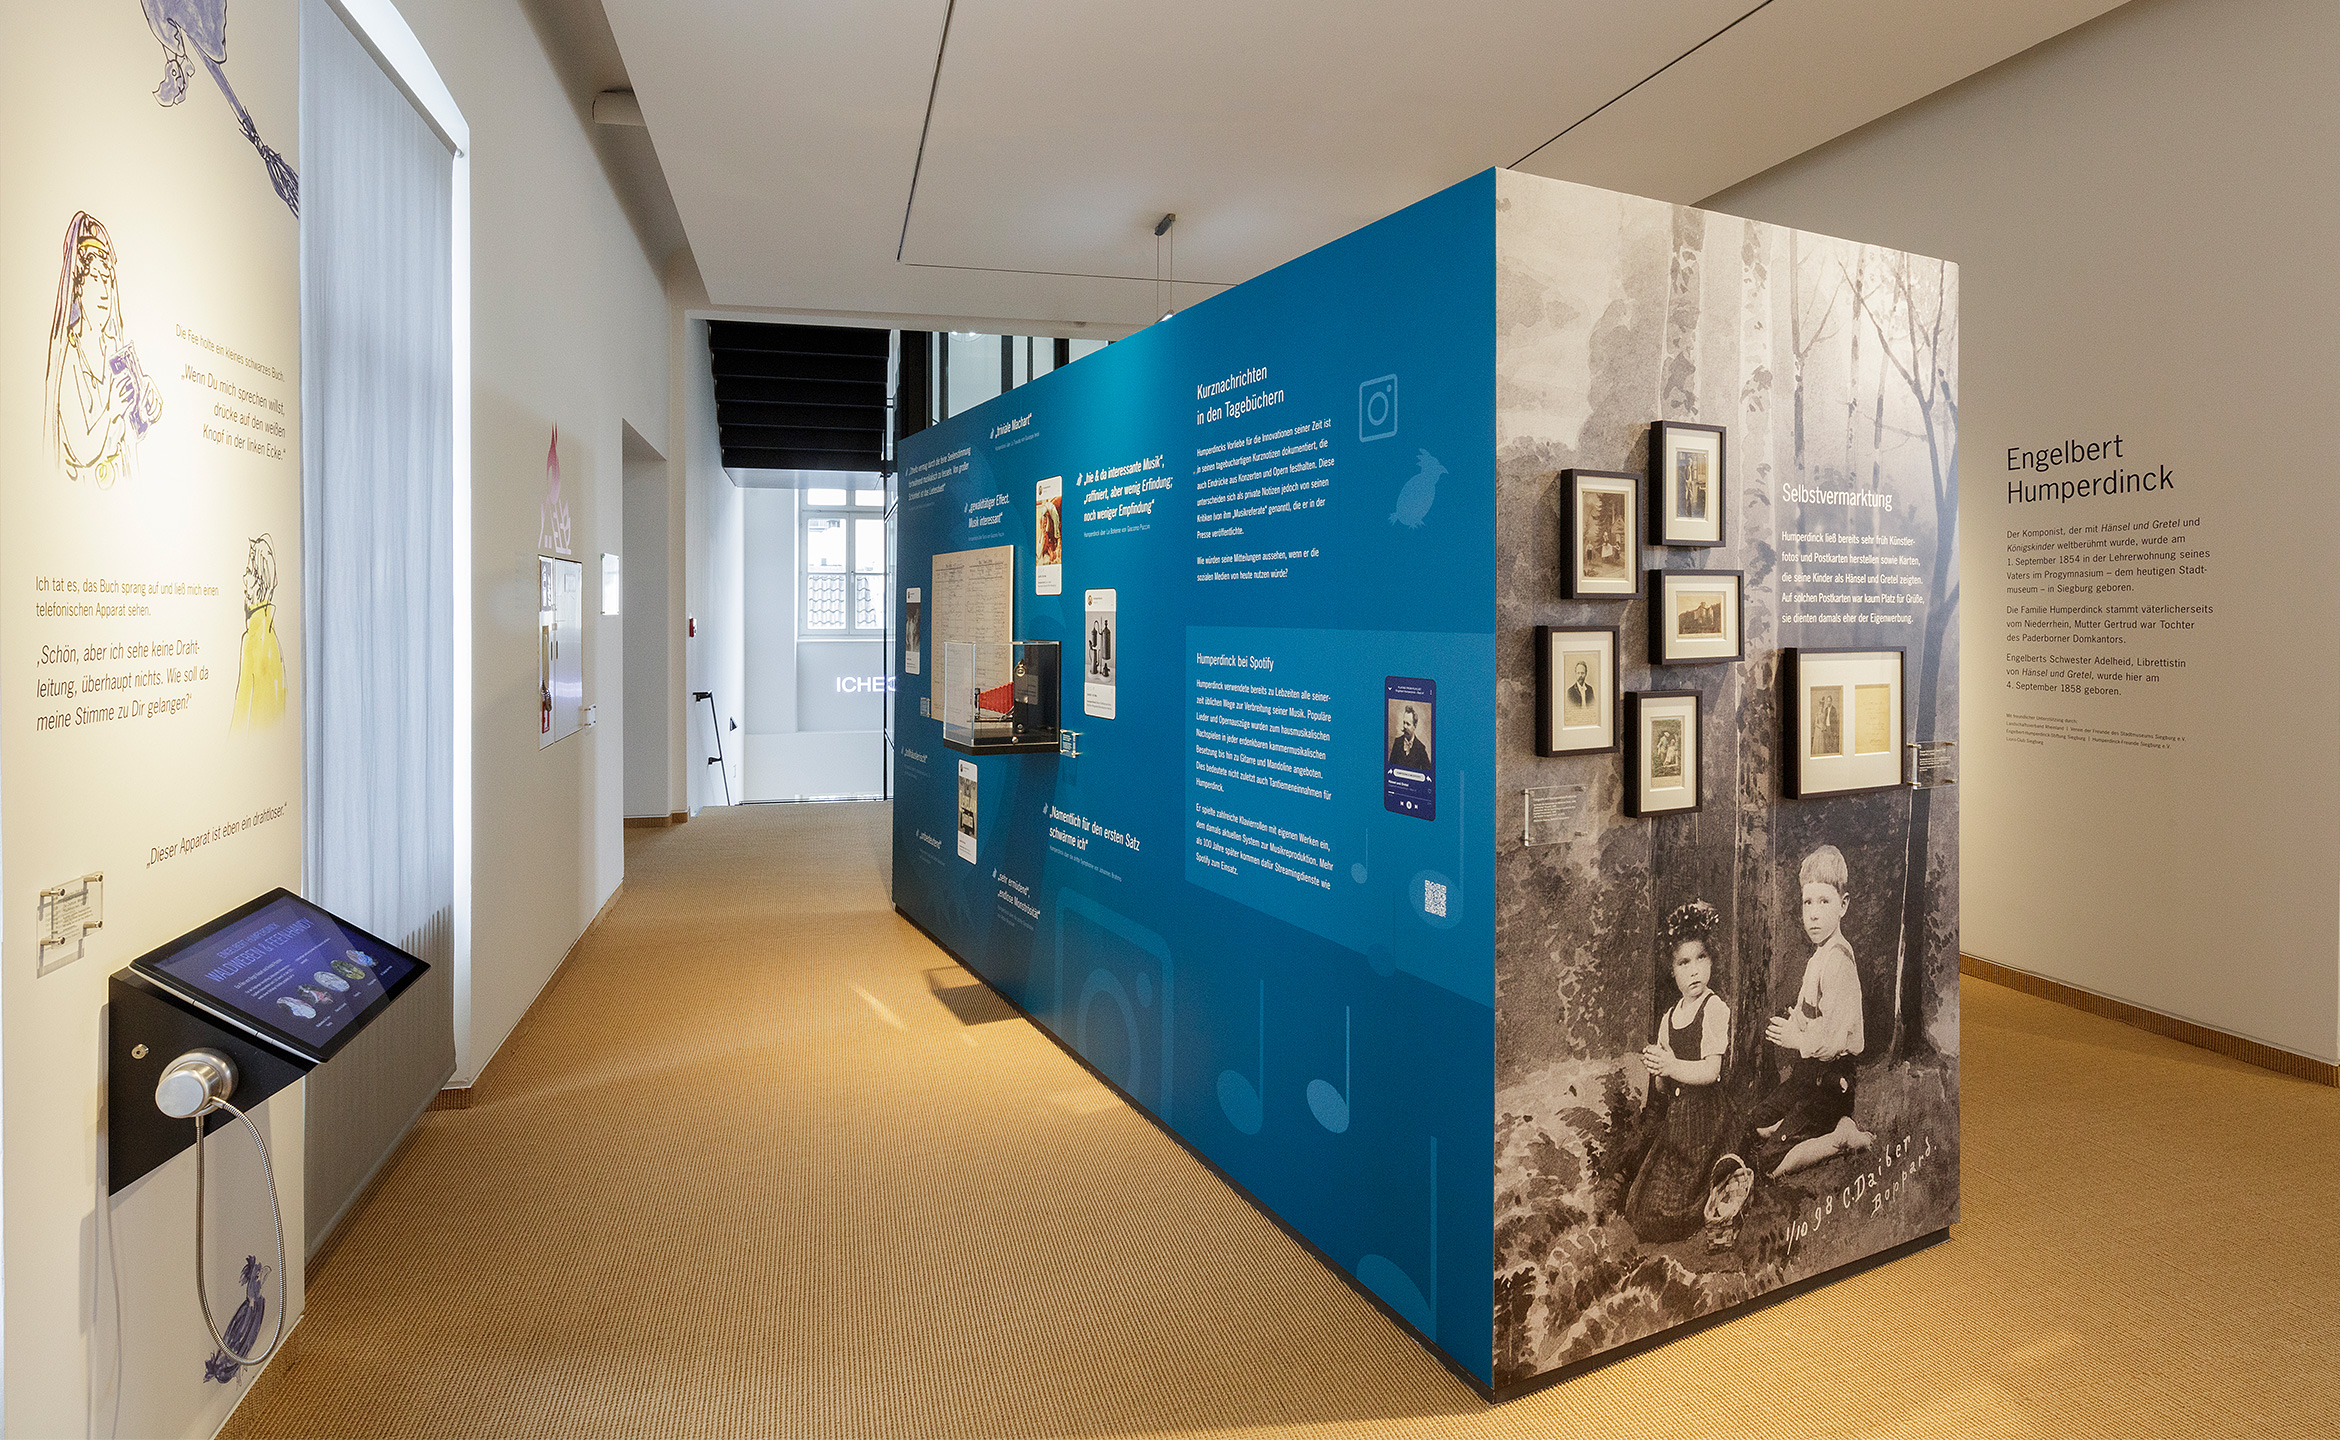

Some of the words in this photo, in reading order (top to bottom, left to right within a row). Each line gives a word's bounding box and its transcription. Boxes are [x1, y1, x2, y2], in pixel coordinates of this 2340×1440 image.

[176, 325, 186, 341] Die
[188, 330, 199, 346] Fee
[200, 335, 214, 353] holte
[216, 343, 224, 357] ein
[225, 346, 244, 365] kleines
[245, 356, 271, 376] schwarzes
[271, 365, 285, 382] Buch.
[207, 373, 218, 391] Du
[219, 380, 236, 397] mich
[237, 387, 267, 408] sprechen
[268, 397, 285, 416] willst,
[1197, 367, 1267, 400] Kurznachrichten
[214, 404, 238, 424] drücke
[239, 414, 250, 427] auf
[251, 415, 263, 431] den
[265, 422, 286, 438] weißen
[1197, 409, 1204, 426] in
[1206, 406, 1222, 423] den
[1224, 390, 1284, 419] Tagebüchern
[203, 424, 225, 447] Knopf
[226, 431, 232, 447] in
[234, 434, 246, 450] der
[247, 437, 265, 456] linken
[2007, 436, 2123, 473] Engelbert
[1094, 469, 1099, 483] &
[1100, 468, 1107, 482] da
[1108, 462, 1142, 480] interessante
[1142, 455, 1164, 473] Musik“,
[1110, 486, 1123, 499] aber
[1124, 482, 1141, 497] wenig
[1141, 478, 1173, 494] Erfindung;
[1782, 483, 1892, 513] Selbstvermarktung
[2008, 466, 2174, 505] Humperdinck
[1083, 508, 1096, 522] noch
[1097, 507, 1118, 521] weniger
[2007, 530, 2020, 539] Der
[2022, 527, 2066, 539] Komponist,
[2068, 525, 2082, 535] der
[2085, 524, 2098, 534] mit
[2101, 522, 2130, 533] Hänsel
[2133, 520, 2150, 531] und
[2152, 518, 2180, 530] Gretel
[2183, 517, 2200, 528] und
[1781, 531, 1824, 545] Humperdinck
[1825, 533, 1837, 544] ließ
[1838, 534, 1860, 544] bereits
[1861, 535, 1875, 545] sehr
[1874, 535, 1888, 546] früh
[1889, 536, 1916, 546] Künstler-
[2007, 557, 2014, 566] 1.
[2015, 555, 2056, 567] September
[2059, 554, 2080, 564] 1854
[2083, 554, 2090, 563] in
[2092, 553, 2106, 563] der
[2109, 551, 2176, 562] Lehrerwohnung
[2179, 549, 2210, 559] seines
[36, 577, 50, 593] Ich
[52, 578, 64, 593] tat
[66, 582, 80, 595] es,
[82, 579, 98, 594] das
[100, 580, 119, 594] Buch
[121, 584, 146, 597] sprang
[148, 582, 159, 595] auf
[2006, 571, 2030, 580] Vaters
[2032, 570, 2042, 579] im
[2044, 568, 2104, 581] Progymnasium
[2114, 568, 2134, 577] dem
[2136, 566, 2176, 578] heutigen
[2179, 565, 2207, 576] Stadt-
[35, 602, 93, 617] telefonischen
[95, 602, 126, 620] Apparat
[128, 603, 151, 617] sehen.
[1781, 613, 1792, 623] sie
[1793, 613, 1817, 623] dienten
[1818, 613, 1842, 623] damals
[1842, 614, 1857, 623] eher
[1858, 614, 1869, 623] der
[1870, 614, 1914, 626] Eigenwerbung.
[2006, 605, 2018, 614] Die
[2021, 605, 2048, 614] Familie
[2049, 605, 2103, 616] Humperdinck
[2105, 605, 2138, 614] stammt
[2141, 604, 2214, 614] väterlicherseits
[2024, 619, 2072, 630] Niederrhein,
[2074, 620, 2101, 629] Mutter
[2104, 620, 2138, 630] Gertrud
[2140, 622, 2156, 630] war
[2159, 620, 2195, 630] Tochter
[83, 644, 107, 664] aber
[110, 643, 124, 662] ich
[127, 642, 149, 660] sehe
[151, 641, 174, 659] keine
[176, 640, 200, 657] Draht-
[1196, 653, 1236, 668] Humperdinck
[1237, 655, 1248, 668] bei
[1249, 656, 1274, 672] Spotify
[36, 678, 77, 699] leitung,
[81, 673, 132, 694] überhaupt
[134, 670, 163, 688] nichts.
[167, 668, 181, 685] Wie
[184, 666, 198, 683] soll
[199, 666, 208, 681] da
[36, 709, 72, 732] meine
[74, 706, 114, 726] Stimme
[117, 706, 129, 720] zu
[131, 700, 145, 718] Dir
[179, 830, 210, 856] Apparat
[212, 826, 221, 843] ist
[222, 822, 240, 839] eben
[241, 816, 251, 832] ein
[1049, 828, 1076, 847] schwärme
[1082, 818, 1090, 833] für
[1091, 822, 1103, 838] den
[1104, 829, 1124, 846] ersten
[1125, 834, 1140, 852] Satz
[204, 947, 266, 982] WALDWEBEN
[265, 917, 314, 948] FEENHANDY
